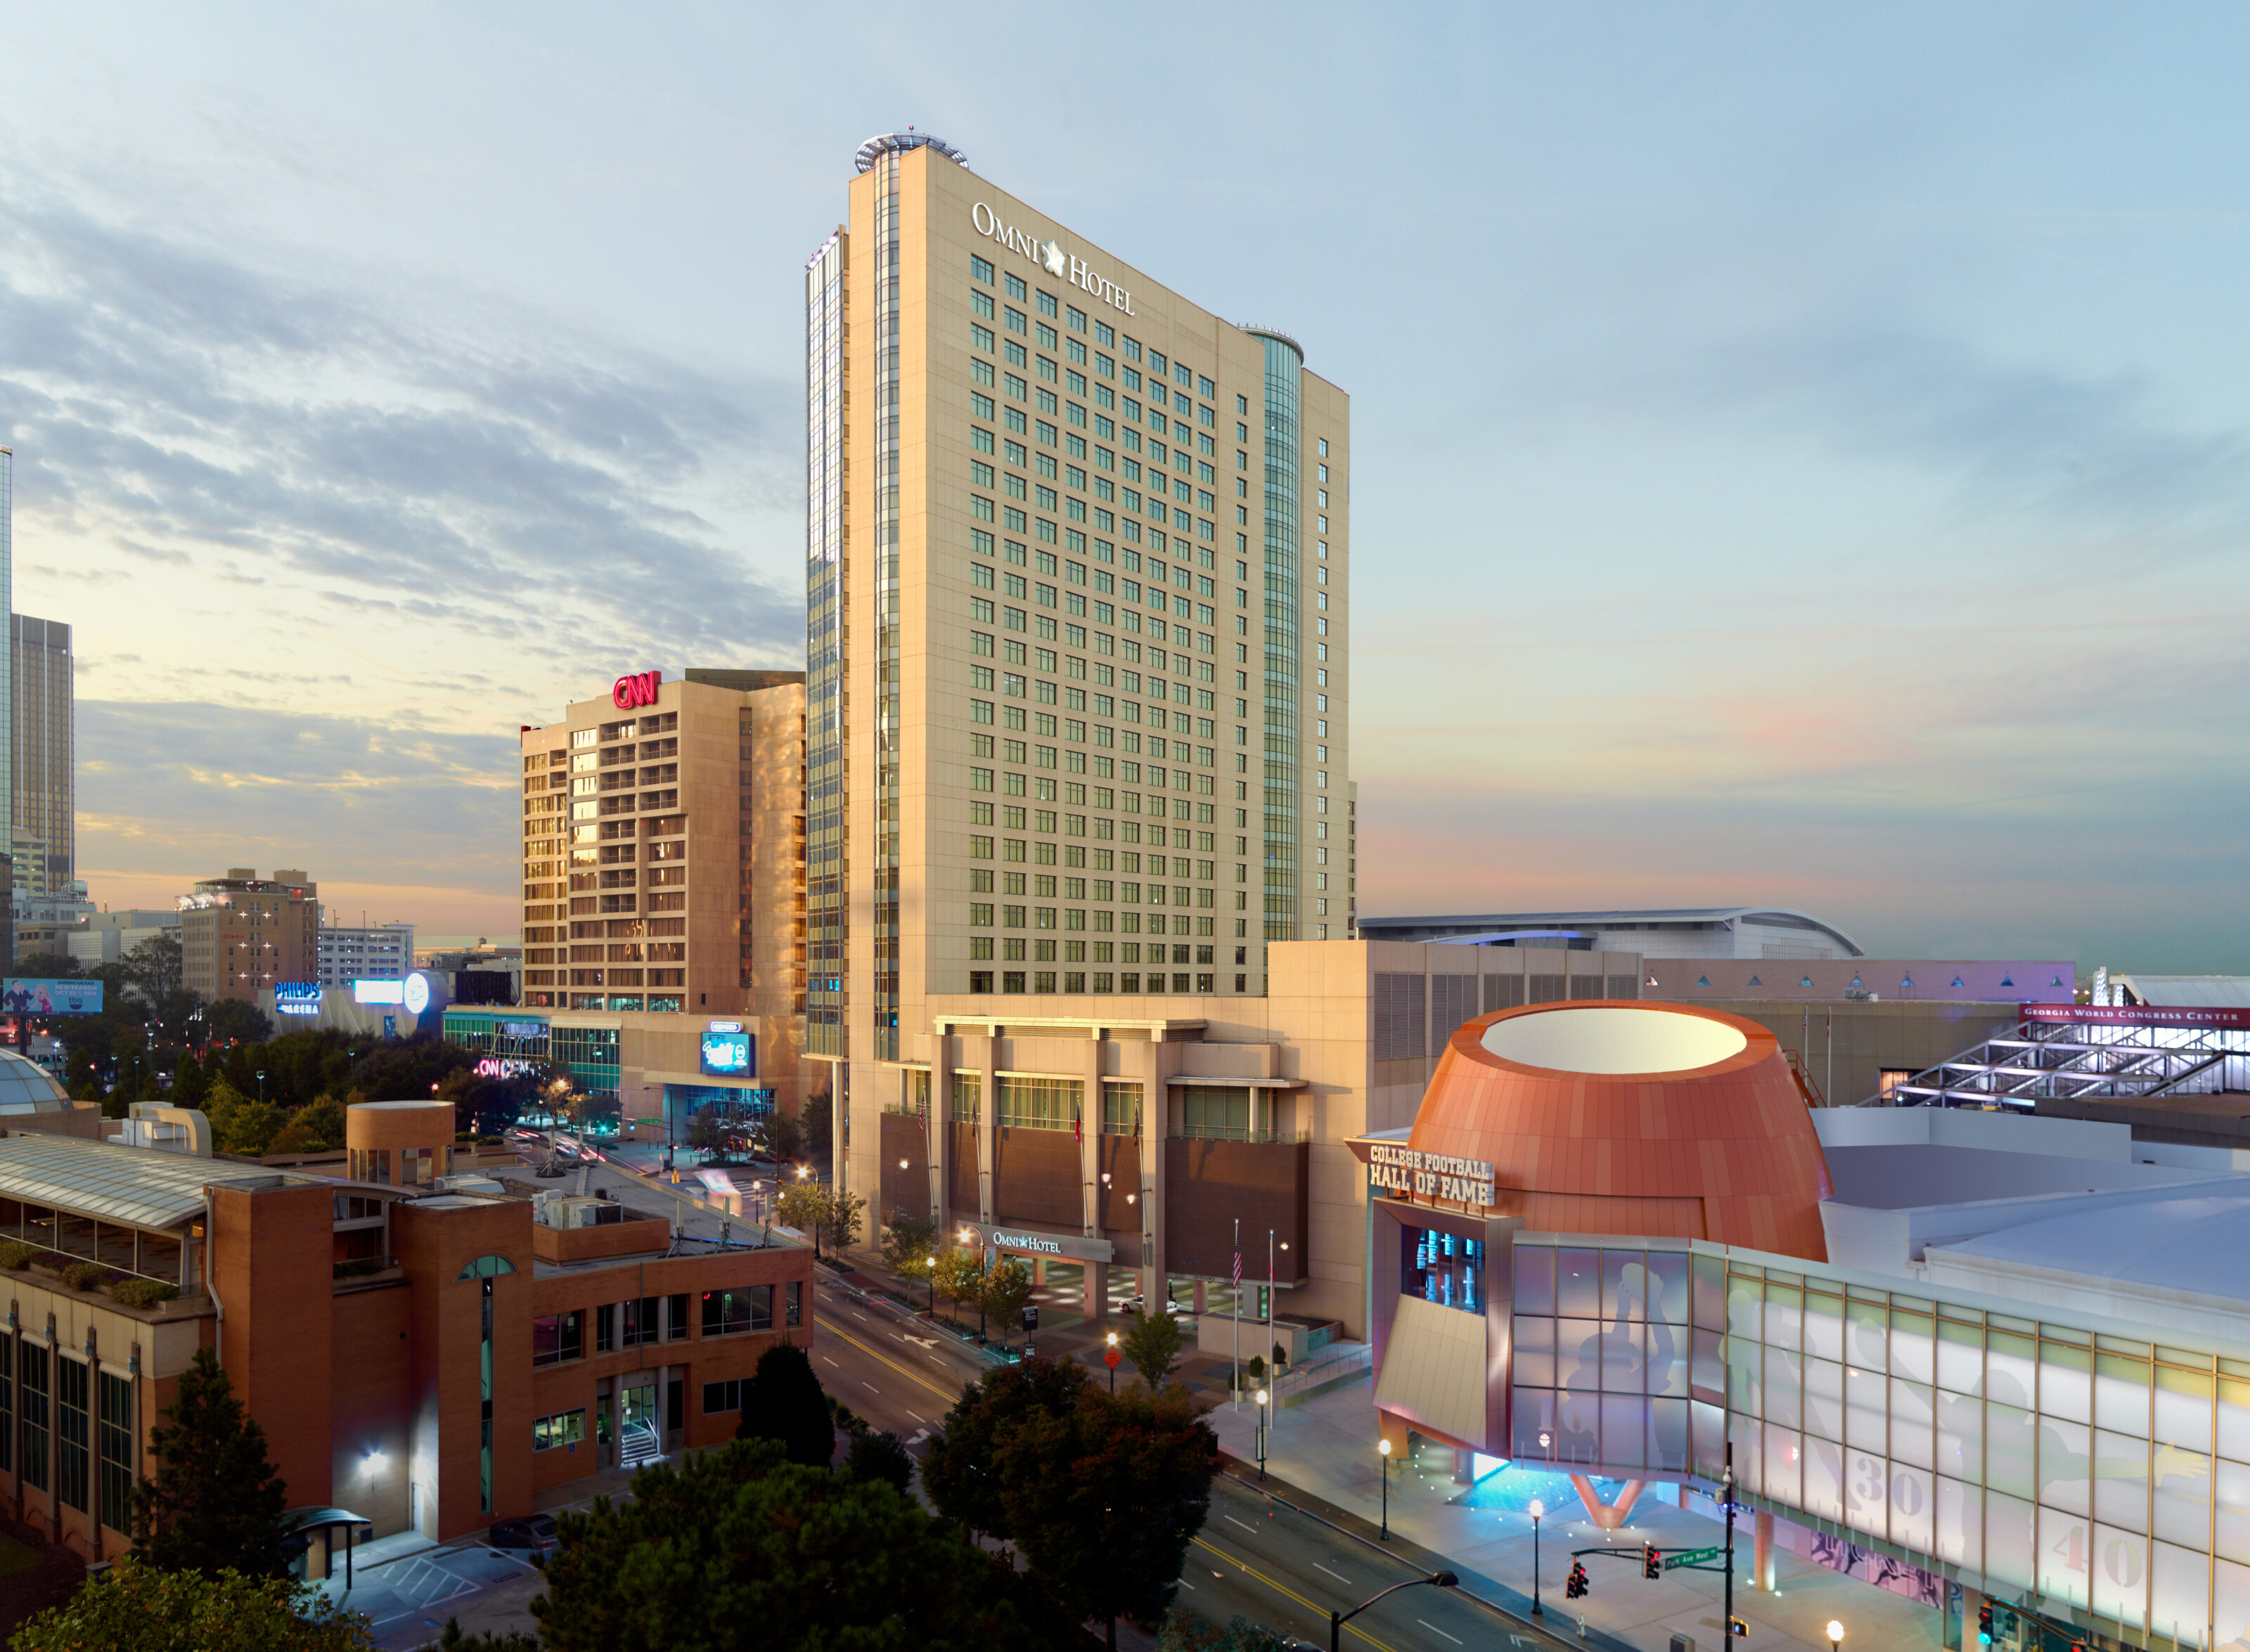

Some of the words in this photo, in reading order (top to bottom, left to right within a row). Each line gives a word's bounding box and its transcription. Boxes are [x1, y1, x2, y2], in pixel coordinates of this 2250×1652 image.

[972, 202, 1039, 264] OMNI
[1067, 253, 1136, 316] HOTEL
[613, 670, 658, 710] CNN
[275, 982, 321, 999] PHILIPS
[287, 1005, 319, 1014] ARENA
[2024, 1007, 2071, 1017] GEORGIA
[2074, 1009, 2114, 1017] WORLD
[2118, 1010, 2182, 1019] CONGRESS
[2187, 1012, 2239, 1021] CENTER
[480, 1059, 500, 1077] CNN
[1370, 1145, 1422, 1168] COLLEGE
[1425, 1153, 1491, 1180] FOOTBALL
[1370, 1163, 1410, 1192] HALL
[1415, 1172, 1436, 1195] OF
[1441, 1175, 1491, 1206] FAME
[993, 1232, 1019, 1247] OMNI
[1028, 1237, 1062, 1253] HOTEL
[1856, 1457, 1923, 1516] 30
[1667, 1557, 1679, 1568] Park
[1696, 1551, 1709, 1560] West
[2052, 1525, 2142, 1587] 40
